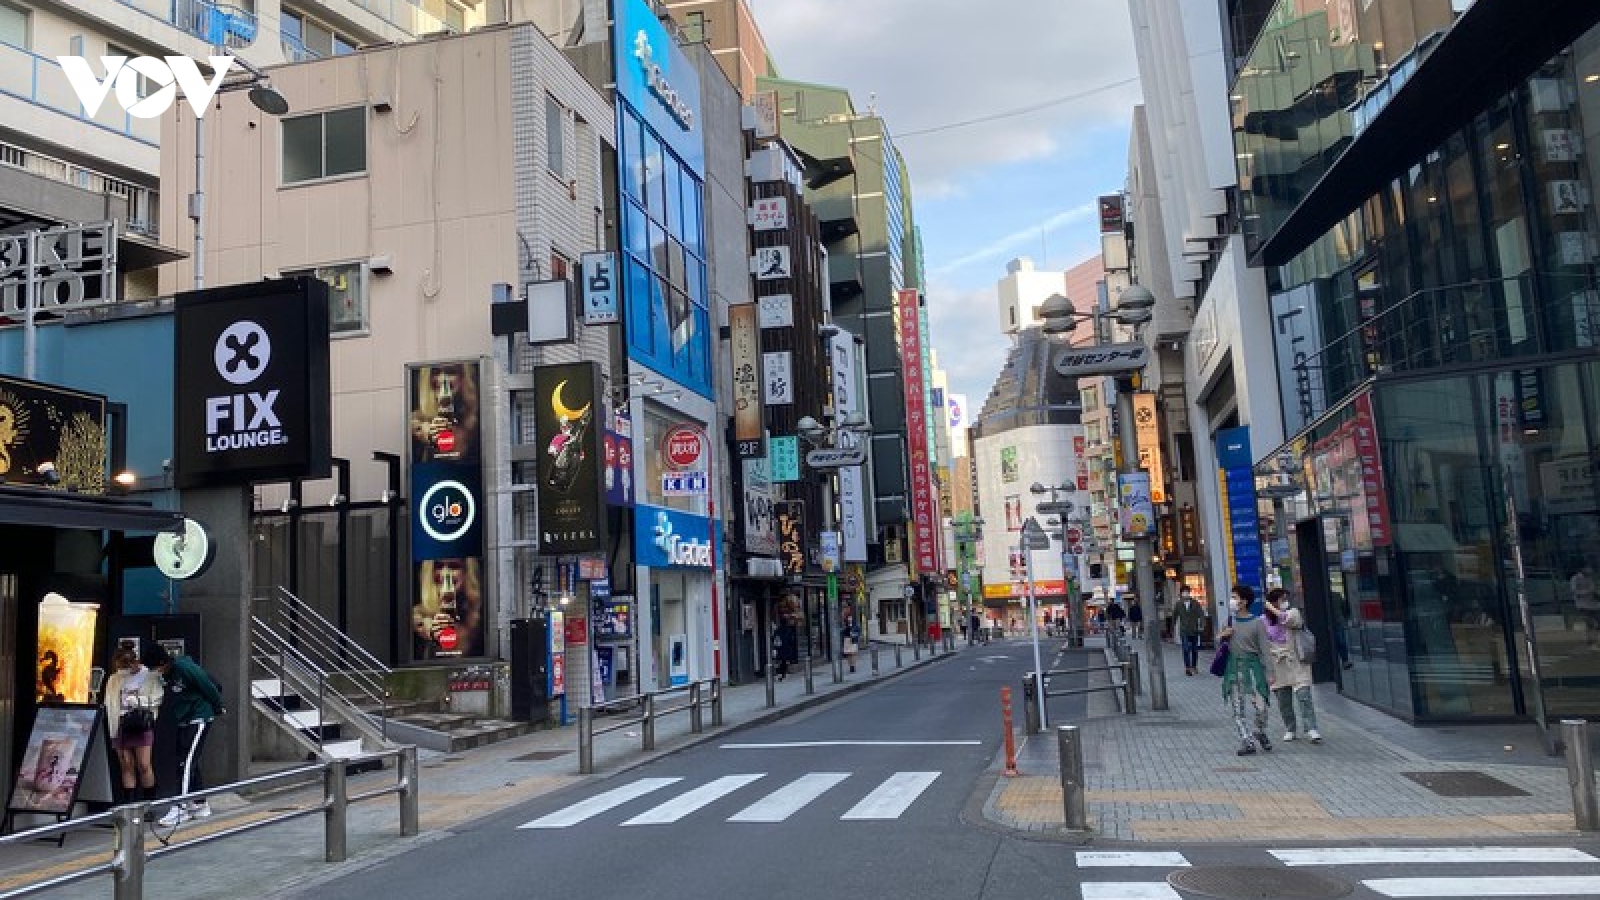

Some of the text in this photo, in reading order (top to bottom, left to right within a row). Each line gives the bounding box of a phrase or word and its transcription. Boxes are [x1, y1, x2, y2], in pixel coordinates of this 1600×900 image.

[589, 262, 611, 308] 占い
[206, 389, 282, 434] FIX
[432, 496, 462, 523] glo
